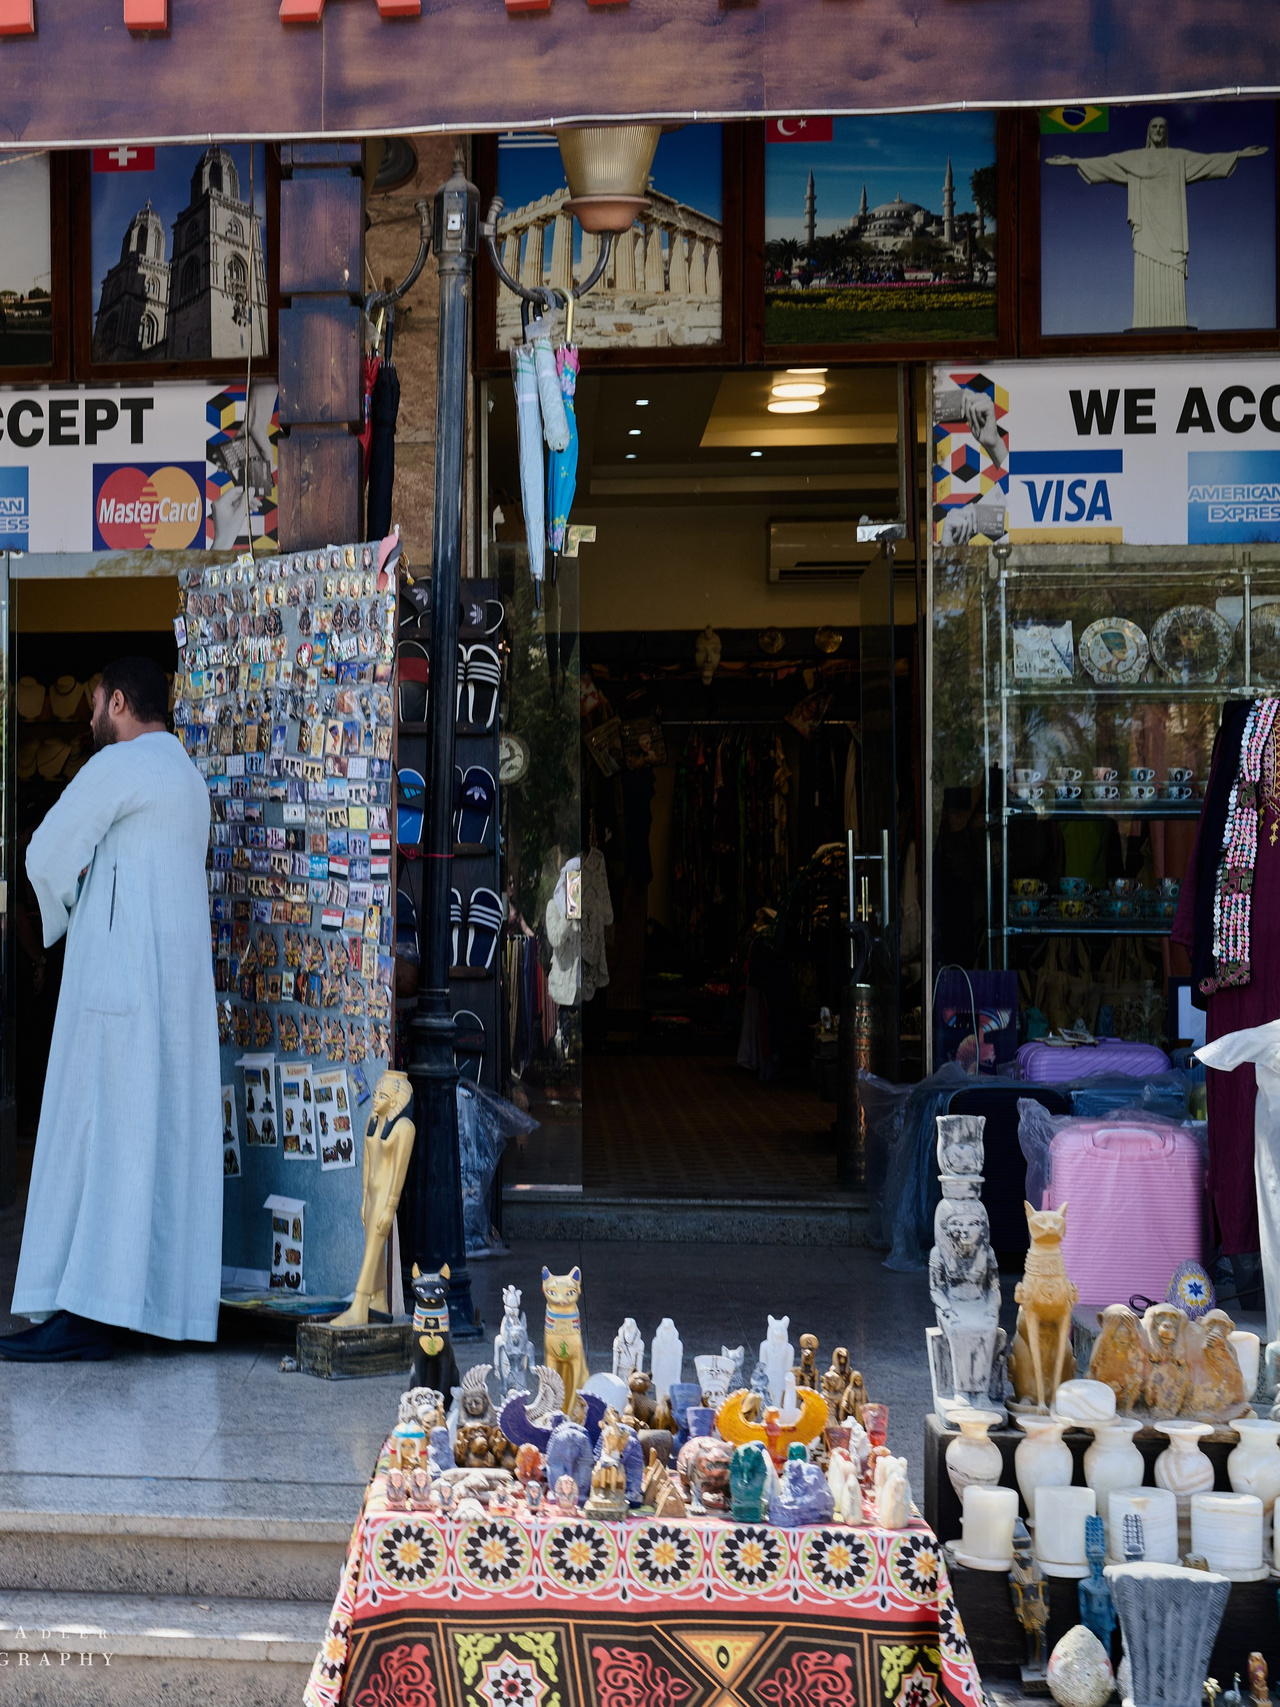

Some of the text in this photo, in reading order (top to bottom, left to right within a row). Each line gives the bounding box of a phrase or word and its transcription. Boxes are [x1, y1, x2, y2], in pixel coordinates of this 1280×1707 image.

[1069, 388, 1157, 435] WE
[99, 497, 200, 523] MasterCard
[1021, 479, 1113, 522] VISA
